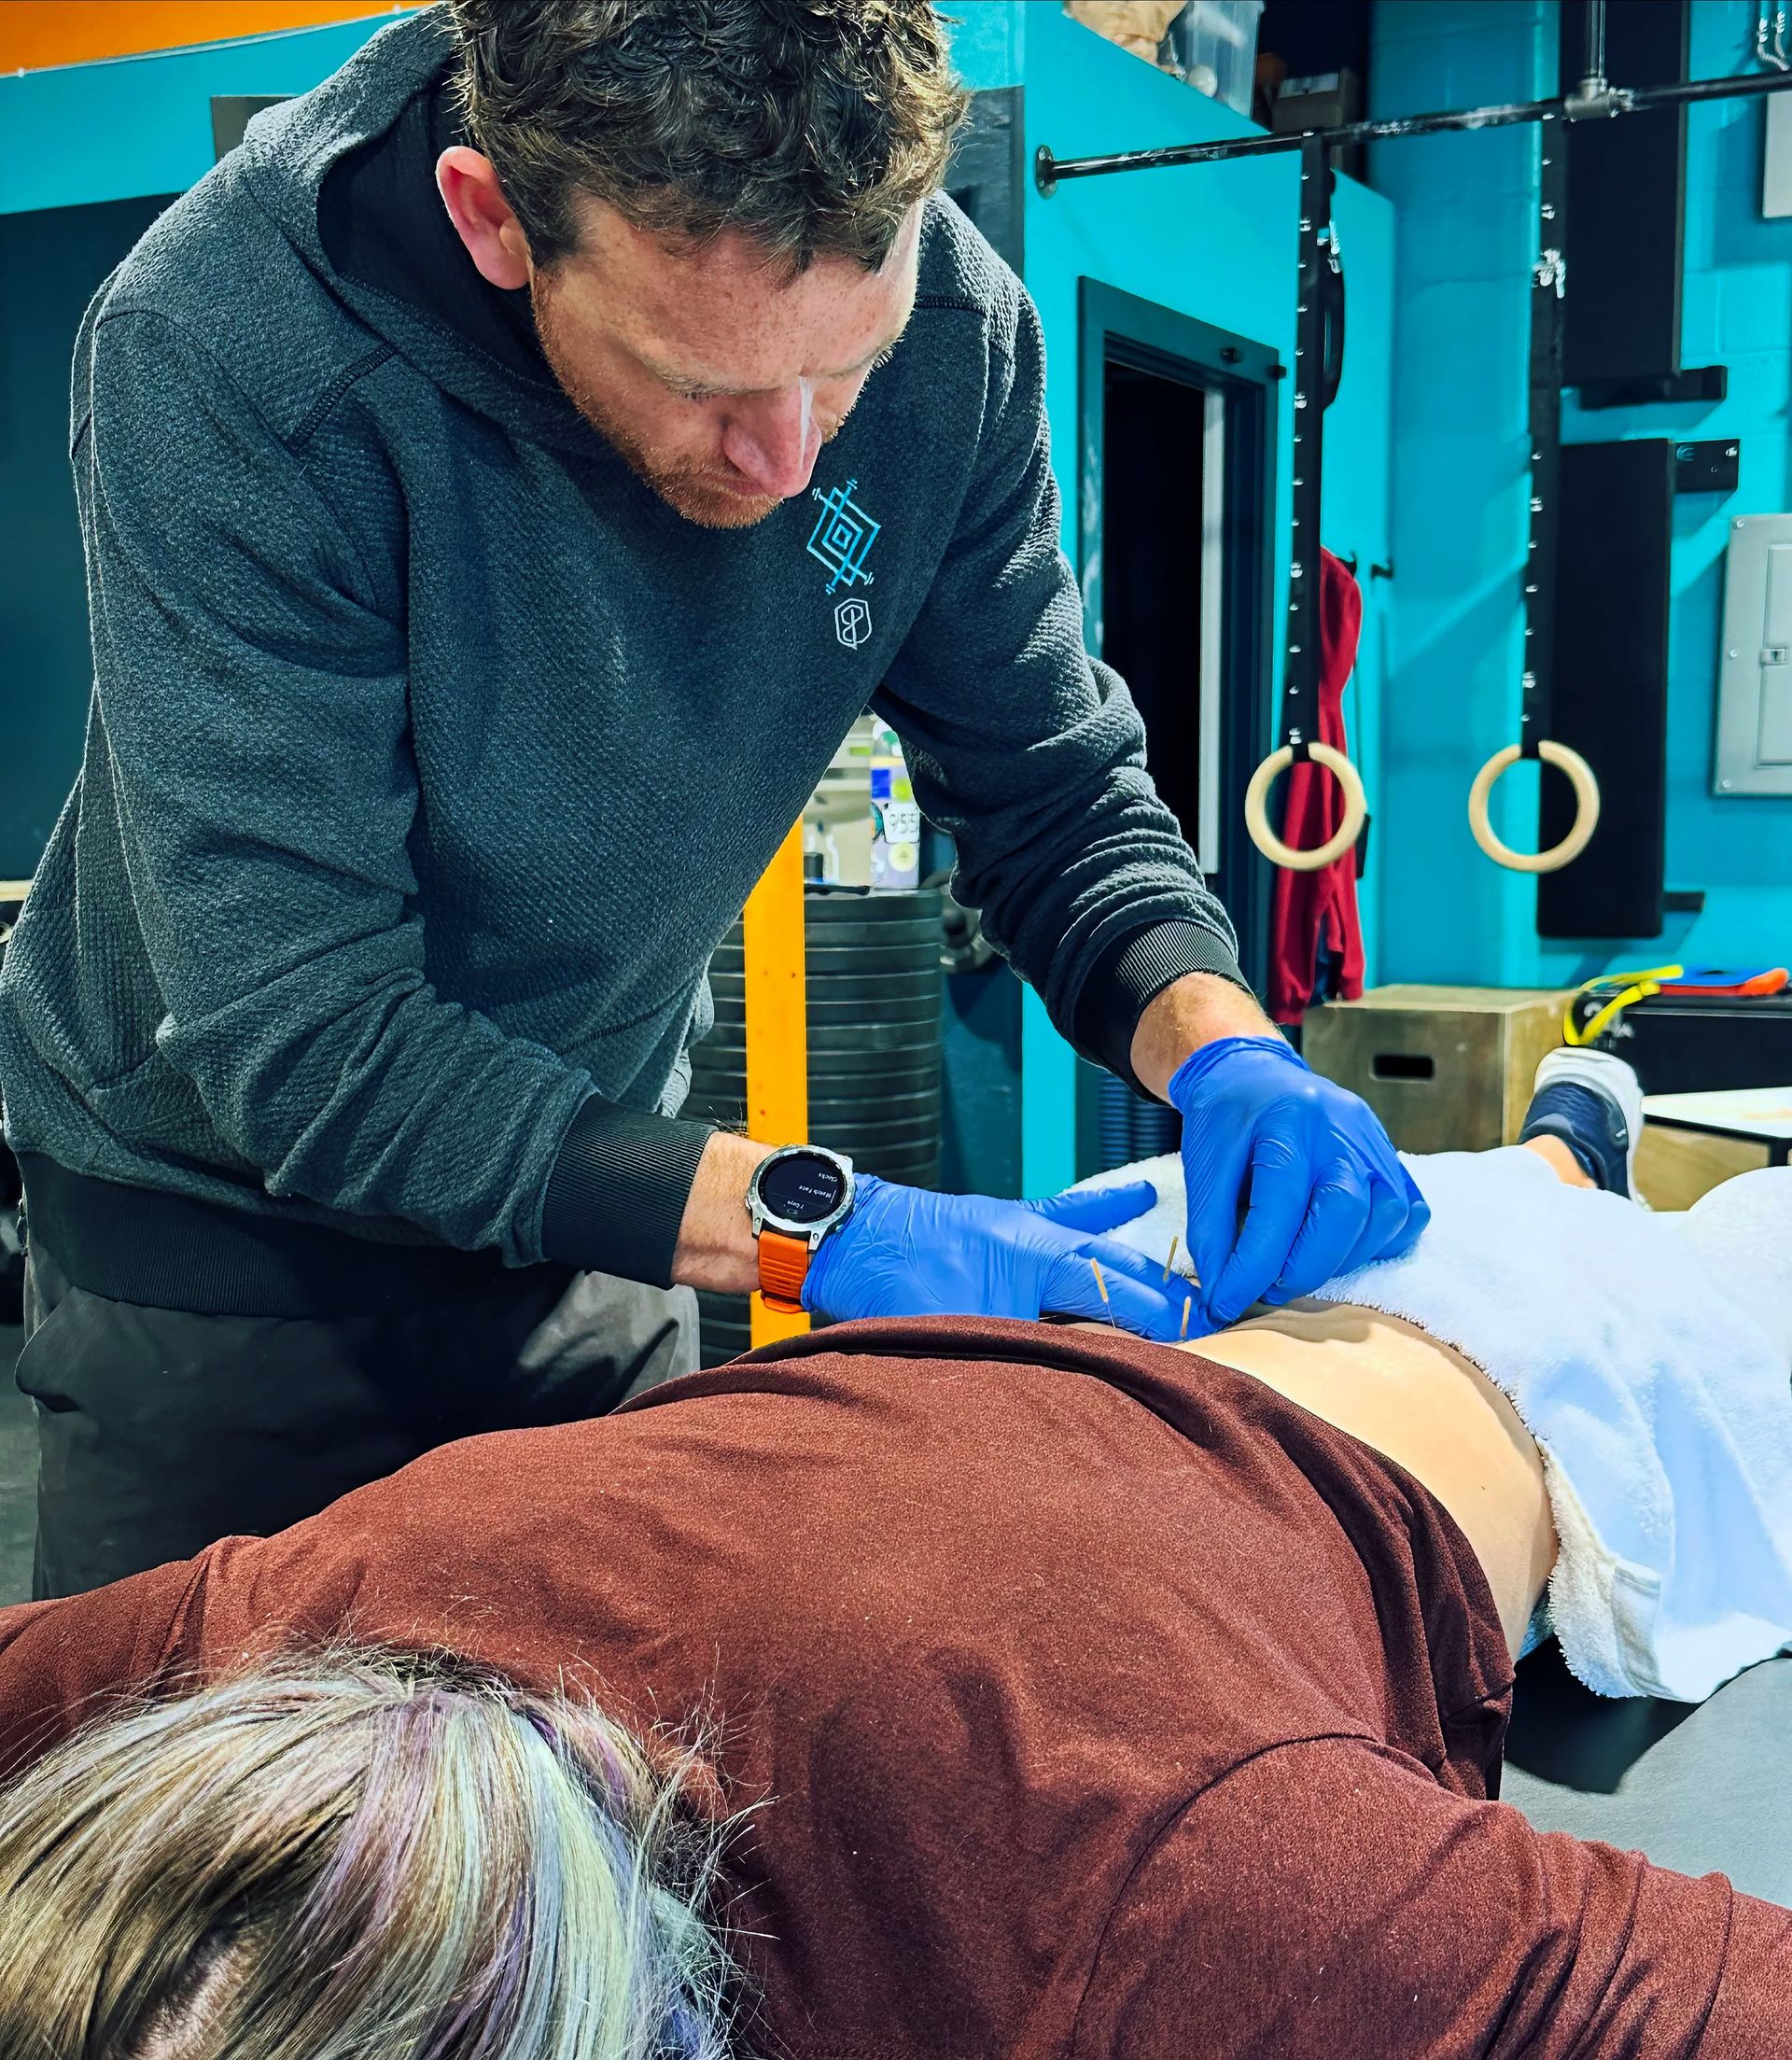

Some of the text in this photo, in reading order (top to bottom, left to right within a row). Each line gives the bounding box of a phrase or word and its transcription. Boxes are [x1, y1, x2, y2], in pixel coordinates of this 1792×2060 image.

[799, 1185, 832, 1198] Watch Face
[787, 1200, 800, 1209] Days
